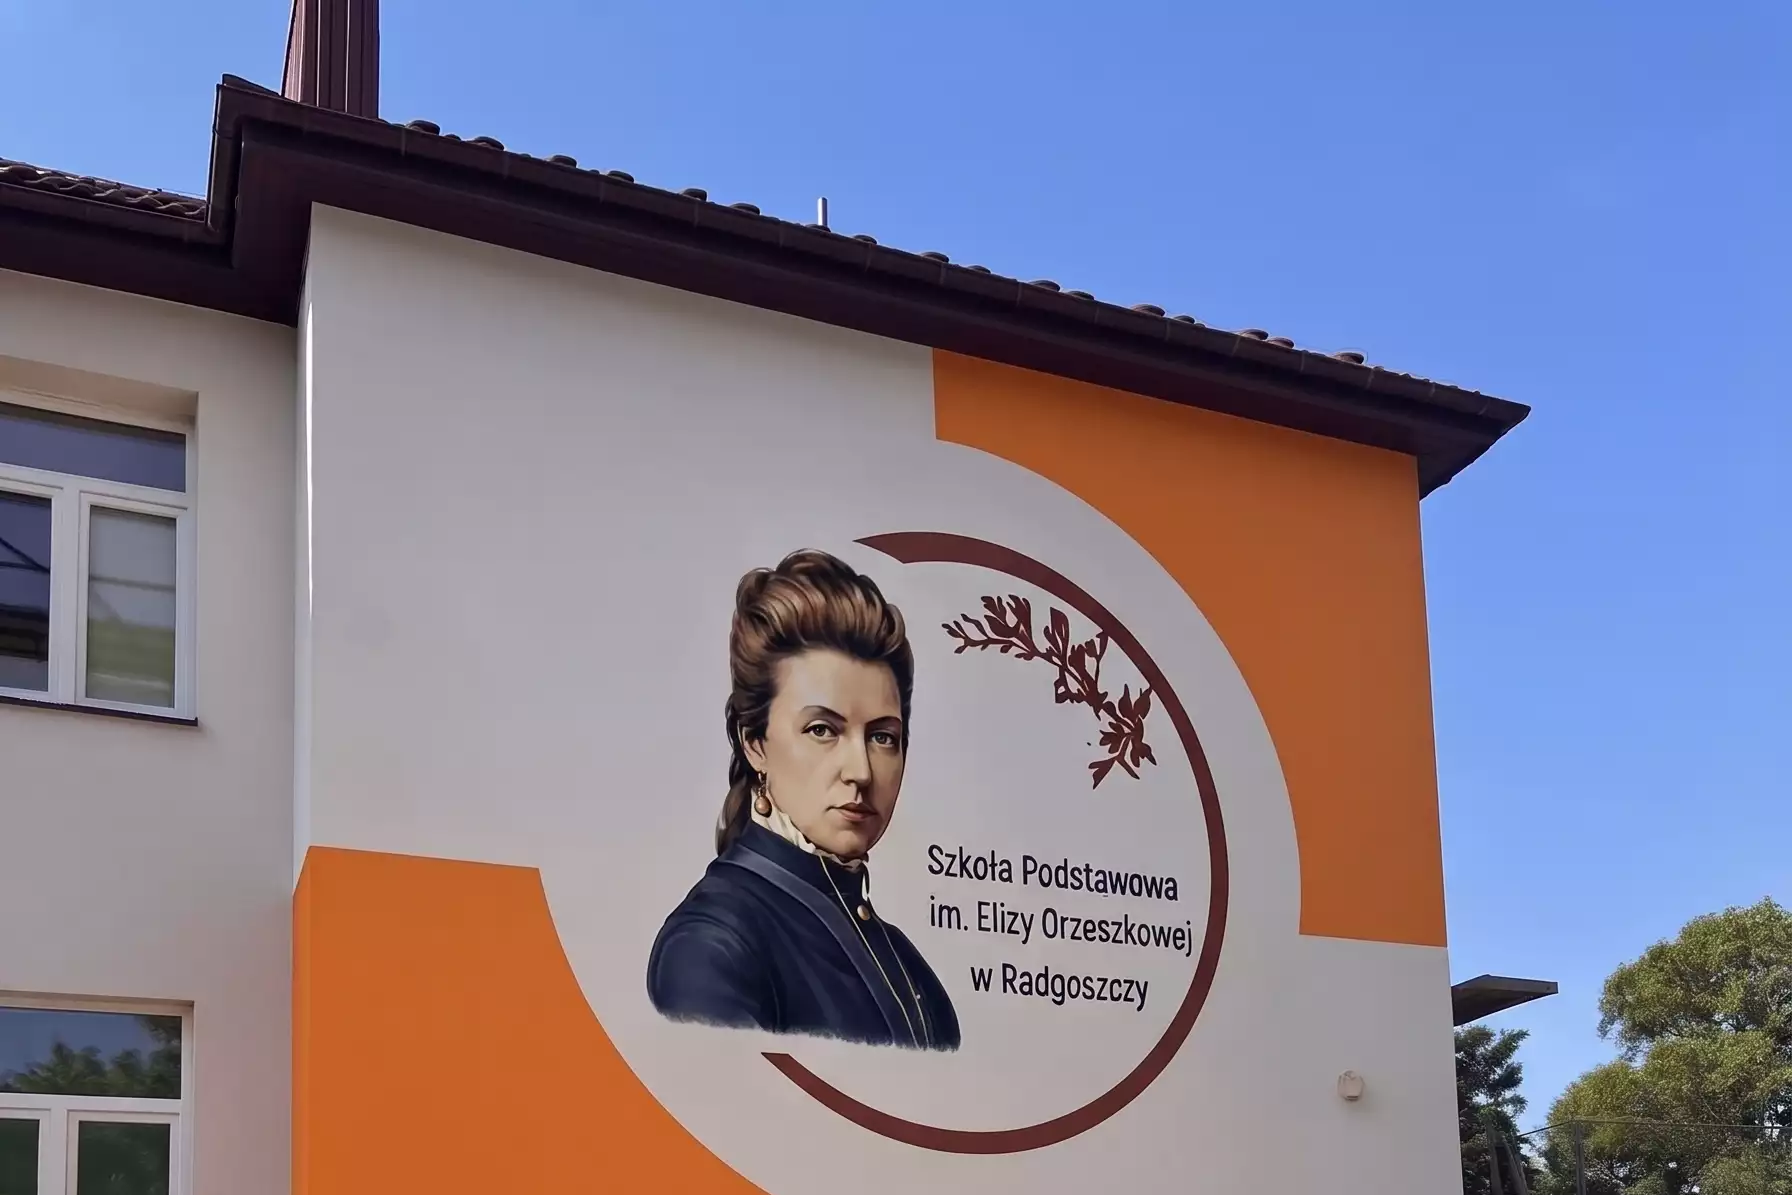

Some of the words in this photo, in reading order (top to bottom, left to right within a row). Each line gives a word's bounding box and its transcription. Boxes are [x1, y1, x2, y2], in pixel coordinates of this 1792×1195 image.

[927, 844, 1014, 884] Szkoła
[1022, 854, 1179, 902] Podstawowa
[929, 894, 969, 932] im.
[977, 900, 1035, 945] Elizy
[1041, 907, 1193, 958] Orzeszkowej
[970, 966, 993, 993] w
[1001, 962, 1149, 1013] Radgoszczy
